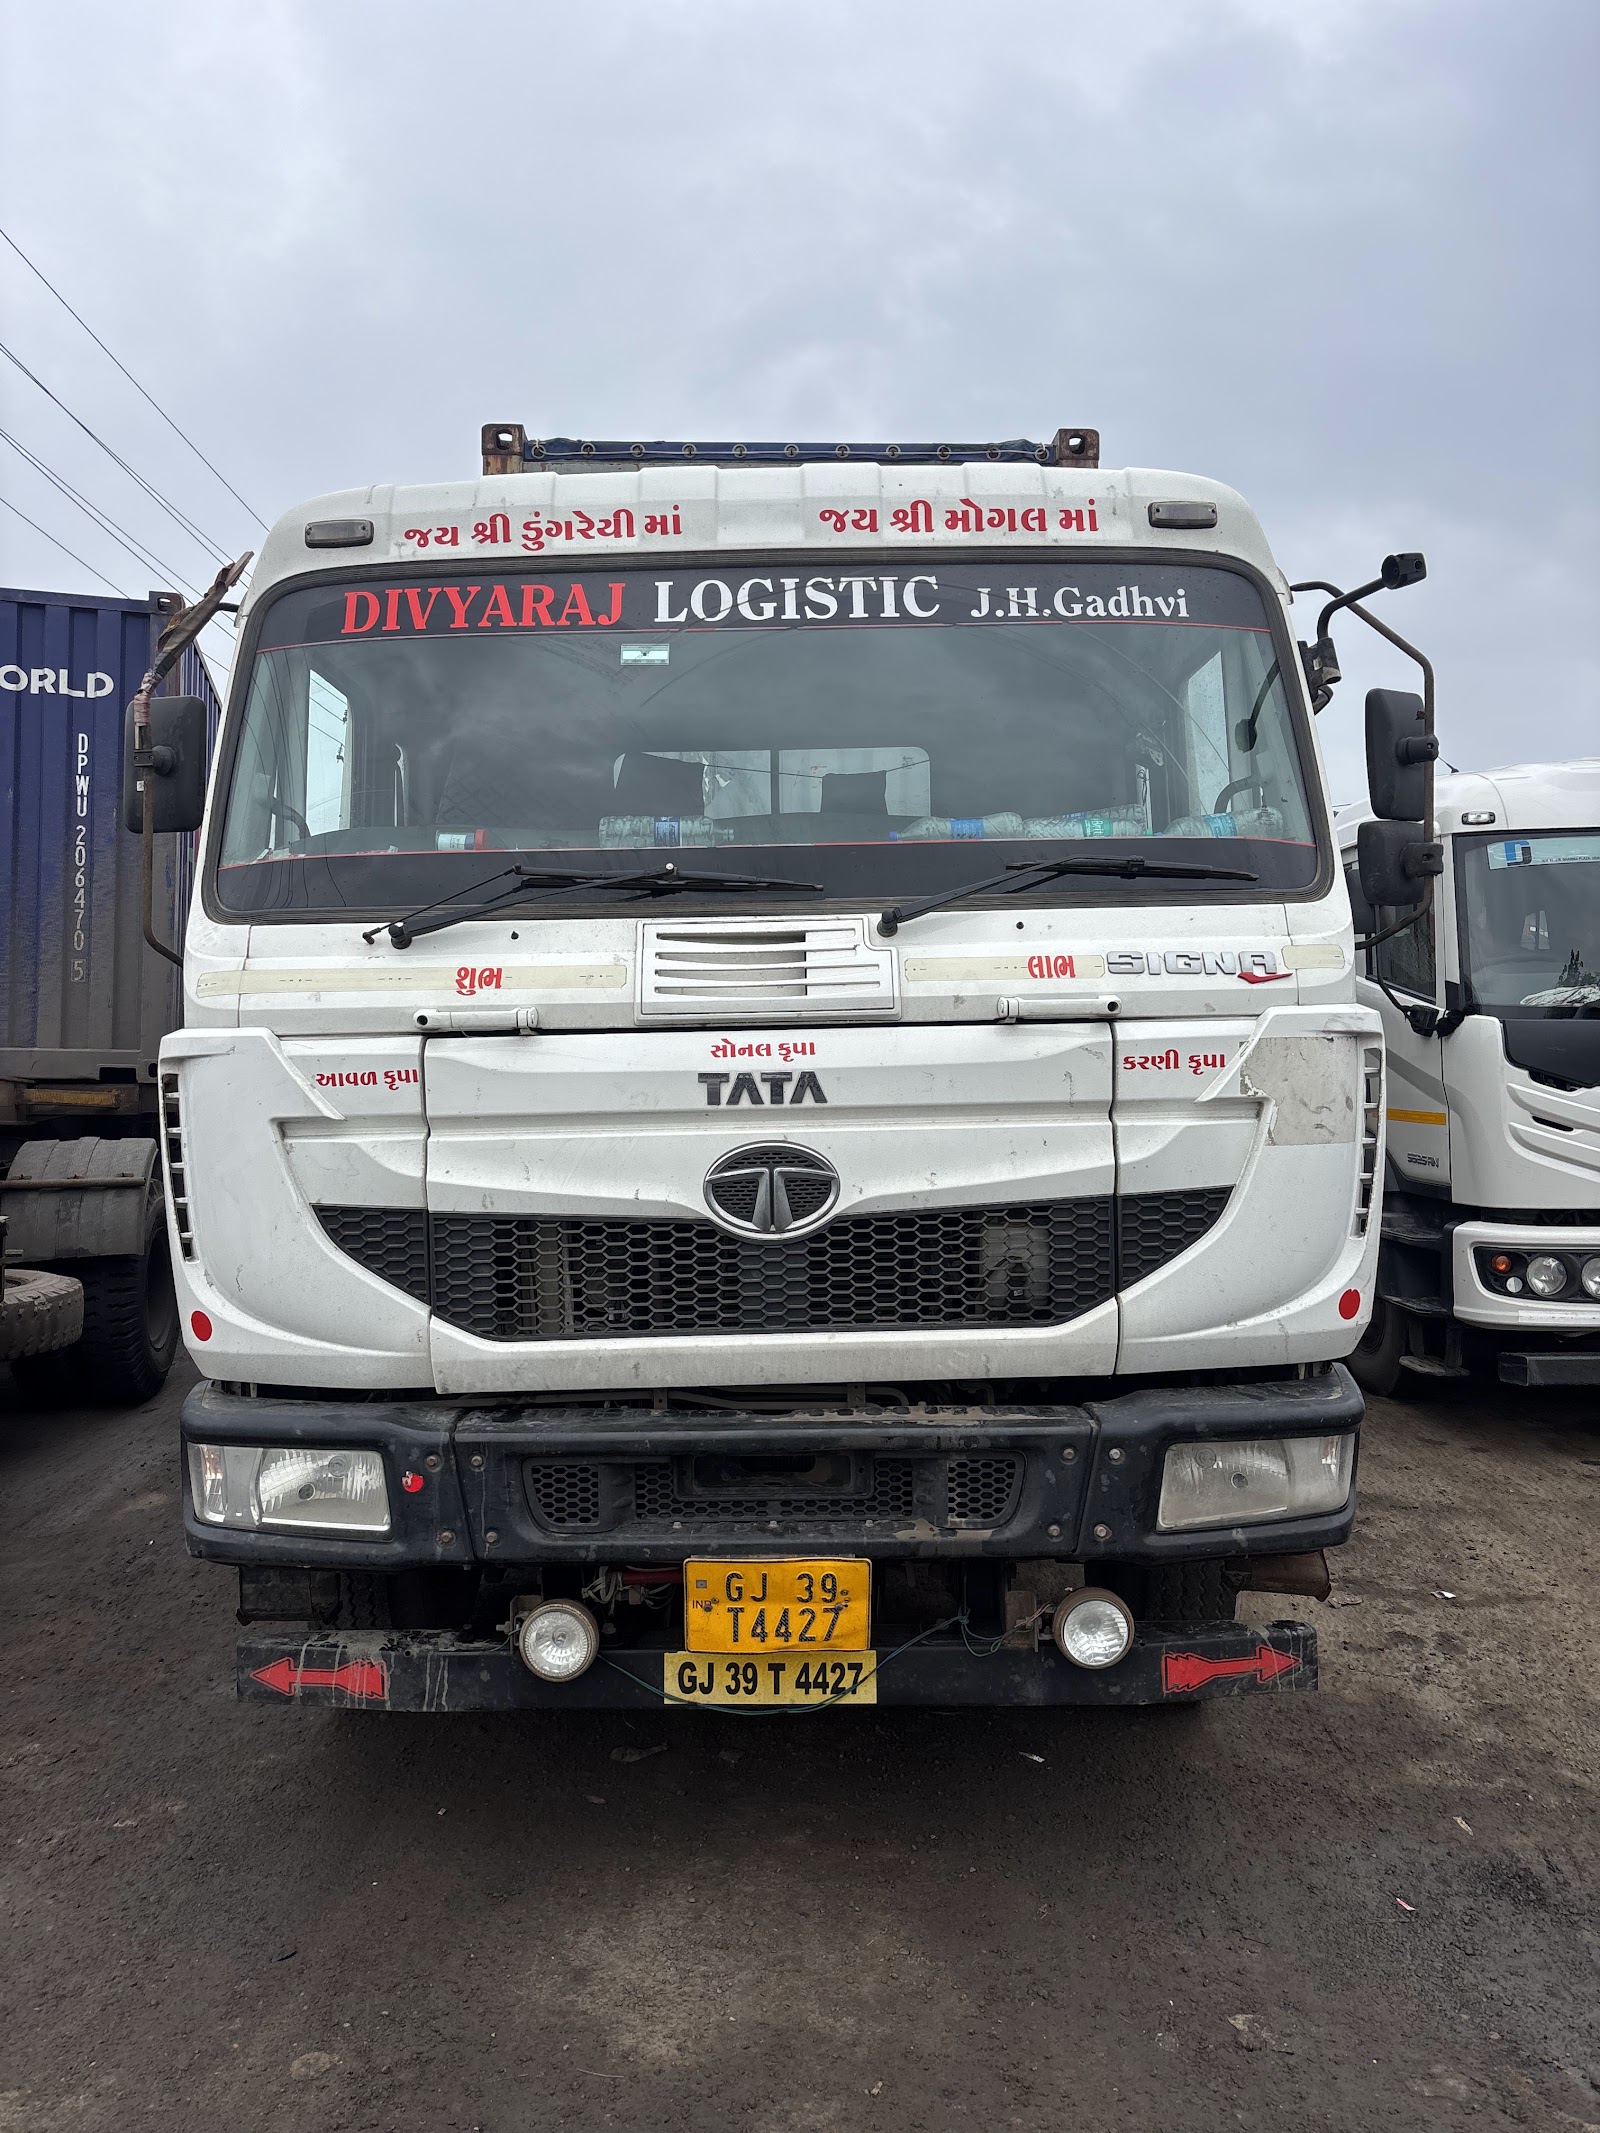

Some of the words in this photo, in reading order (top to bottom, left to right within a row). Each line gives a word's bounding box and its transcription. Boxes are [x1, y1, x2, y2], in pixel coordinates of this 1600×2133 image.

[403, 527, 460, 548] જય
[470, 513, 512, 544] શ્રી
[644, 505, 682, 535] માં
[819, 508, 878, 533] જય
[889, 499, 934, 533] શ્રી
[945, 498, 1047, 533] મોગલ
[1058, 499, 1099, 532] માં
[341, 582, 626, 634] DIVYARAJ
[654, 575, 941, 623] LOGISTIC
[970, 586, 1190, 618] J.H.Gadhvi
[75, 732, 90, 817] DPWU
[73, 825, 86, 951] 206470
[1027, 955, 1077, 979] લાભ
[1106, 950, 1278, 975] SIGNA
[455, 966, 503, 996] શુભ
[710, 1038, 772, 1058] સોનલ
[778, 1041, 817, 1062] કૃપા
[1122, 1048, 1180, 1070] કરણી
[1188, 1053, 1226, 1075] કૃપા
[316, 1071, 378, 1087] આવળ
[383, 1069, 419, 1090] કૃપા
[698, 1071, 828, 1106] TATA
[725, 1571, 768, 1603] GJ
[796, 1572, 838, 1603] 39
[727, 1605, 841, 1643] T4427
[677, 1661, 715, 1695] GJ
[725, 1661, 758, 1695] 39
[767, 1662, 786, 1695] T
[795, 1661, 863, 1695] 4427
